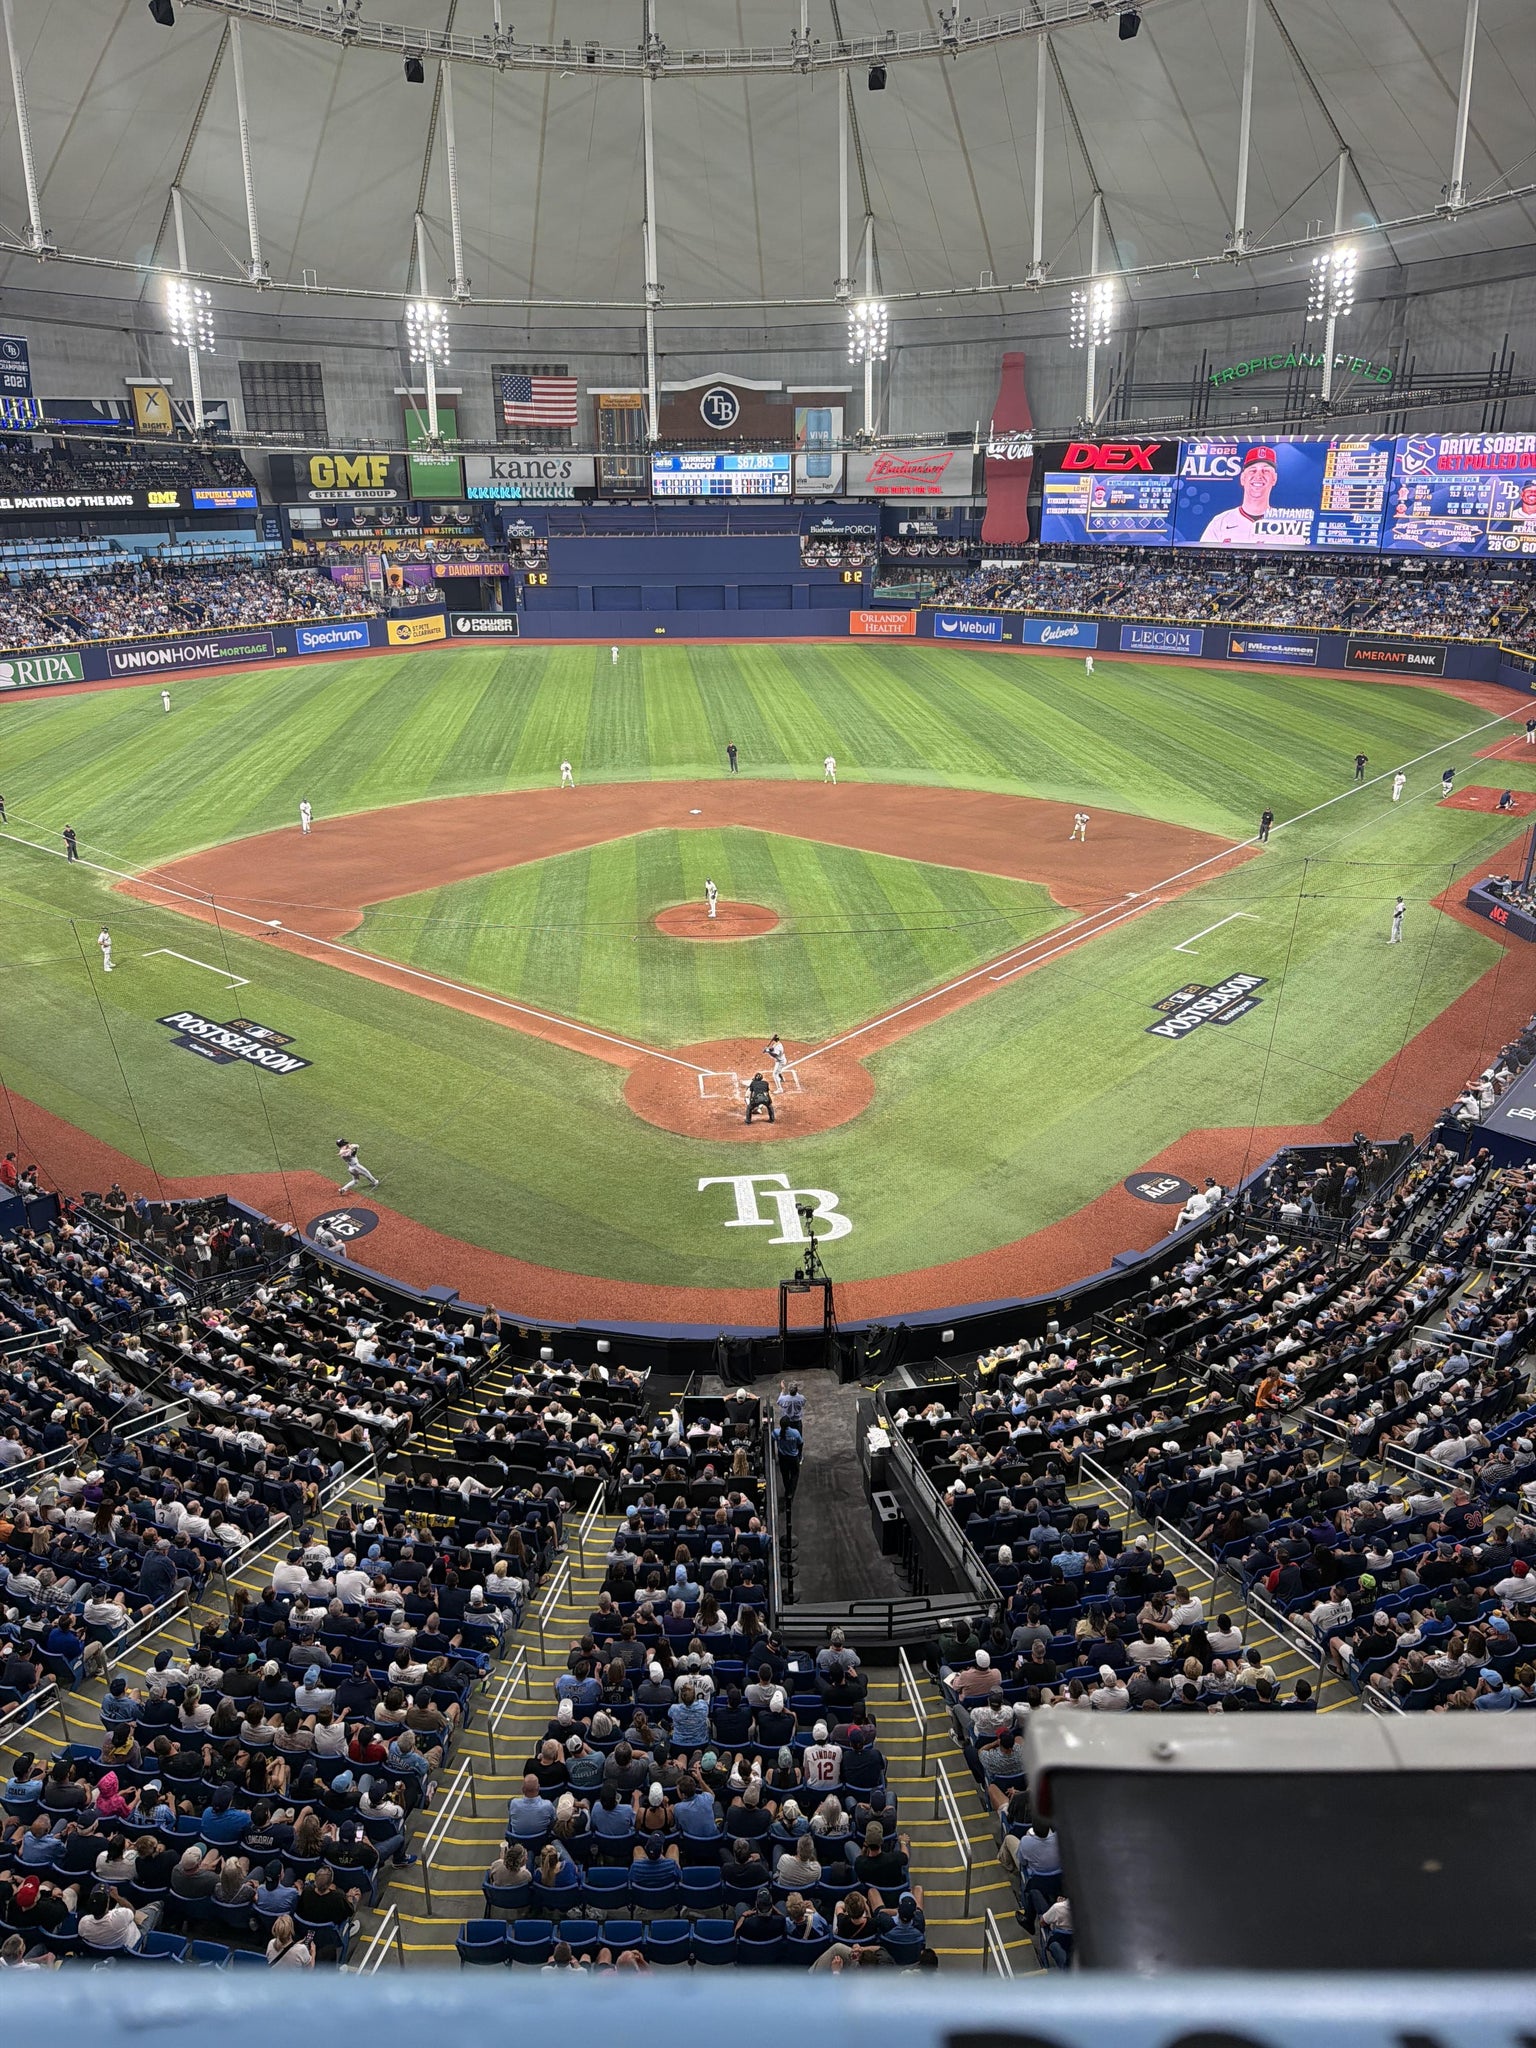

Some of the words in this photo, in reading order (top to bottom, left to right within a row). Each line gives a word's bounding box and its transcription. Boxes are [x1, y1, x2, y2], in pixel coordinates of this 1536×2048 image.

[1208, 353, 1326, 387] TROPICANA
[1334, 353, 1393, 384] FIELD
[4, 375, 27, 388] 2021
[708, 396, 733, 420] TB
[1440, 438, 1482, 454] DRIVE
[1483, 436, 1536, 454] SOBER
[738, 456, 774, 470] $67,883
[1061, 442, 1161, 470] DEX
[1438, 455, 1462, 470] GET
[1464, 454, 1518, 470] PULLED
[309, 456, 390, 488] GMF
[489, 456, 572, 480] kane's
[875, 460, 944, 475] Budweiser
[1180, 456, 1242, 476] ALCS
[774, 474, 788, 486] 1-2
[148, 491, 178, 503] GMF
[195, 491, 230, 499] REPUBLIC
[232, 490, 254, 499] BANK
[1499, 481, 1520, 499] TB
[0, 498, 14, 509] EL
[14, 497, 66, 508] PARTNER
[66, 496, 82, 507] OF
[82, 496, 105, 506] THE
[105, 495, 134, 506] RAYS
[1264, 508, 1314, 519] NATHANIEL
[810, 526, 844, 534] Budweiser
[845, 526, 877, 534] PORCH
[1257, 521, 1311, 536] LOWE
[1488, 542, 1501, 551] 28
[449, 564, 483, 576] DAIQUIRI
[485, 564, 504, 575] DECK
[844, 571, 862, 583] 0:12
[528, 573, 548, 585] 0:12
[860, 613, 907, 623] ORLANDO
[413, 628, 441, 637] CLEARWATER
[865, 624, 902, 632] HEALTH
[960, 621, 995, 634] Webull
[1040, 624, 1079, 643] Culver's
[303, 630, 357, 648] Spectrum
[1132, 630, 1190, 646] LECOM
[1248, 642, 1314, 653] MicroLumen
[1354, 649, 1406, 663] AMERANT
[1407, 654, 1436, 666] BANK
[17, 656, 76, 685] RIPA
[1489, 905, 1509, 923] ACE
[1151, 974, 1263, 1038] POSTSEASON
[163, 1012, 305, 1072] POSTSEASON
[1144, 1178, 1180, 1199] ALCS
[698, 1174, 852, 1244] TB
[159, 1512, 165, 1524] 3
[1464, 1510, 1482, 1529] 30
[812, 1750, 836, 1761] LINDOR
[817, 1761, 834, 1780] 12
